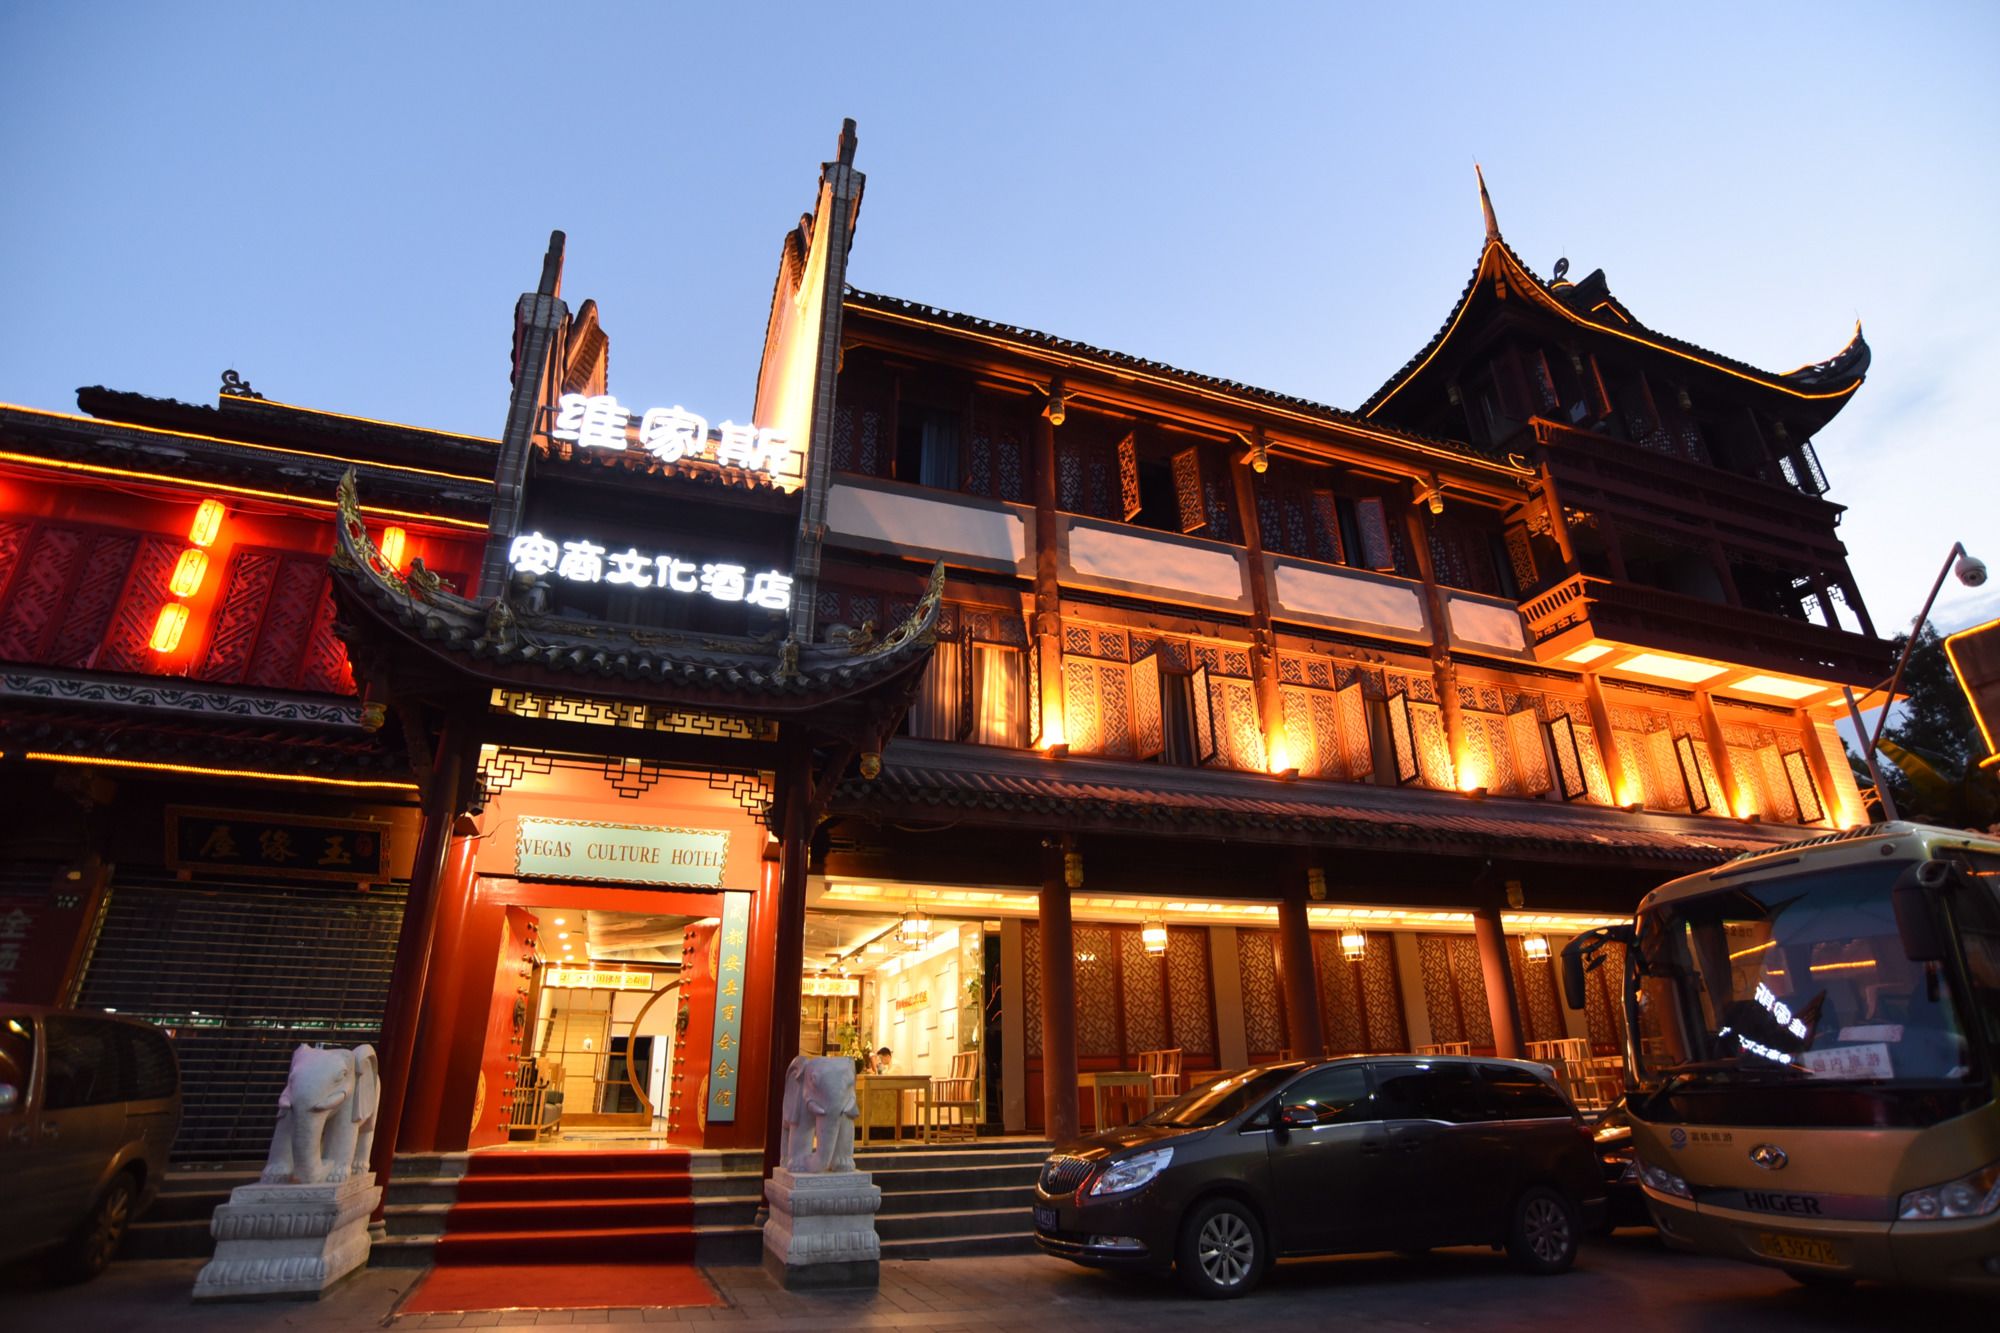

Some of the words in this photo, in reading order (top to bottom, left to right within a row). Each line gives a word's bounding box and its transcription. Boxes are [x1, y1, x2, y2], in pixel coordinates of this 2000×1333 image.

[552, 393, 791, 478] 维家斯
[509, 531, 793, 610] 安商文化酒店
[522, 838, 572, 858] VEGAS
[587, 842, 661, 864] CULTURE
[671, 848, 722, 867] HOTEL
[1744, 1191, 1823, 1215] HIGER
